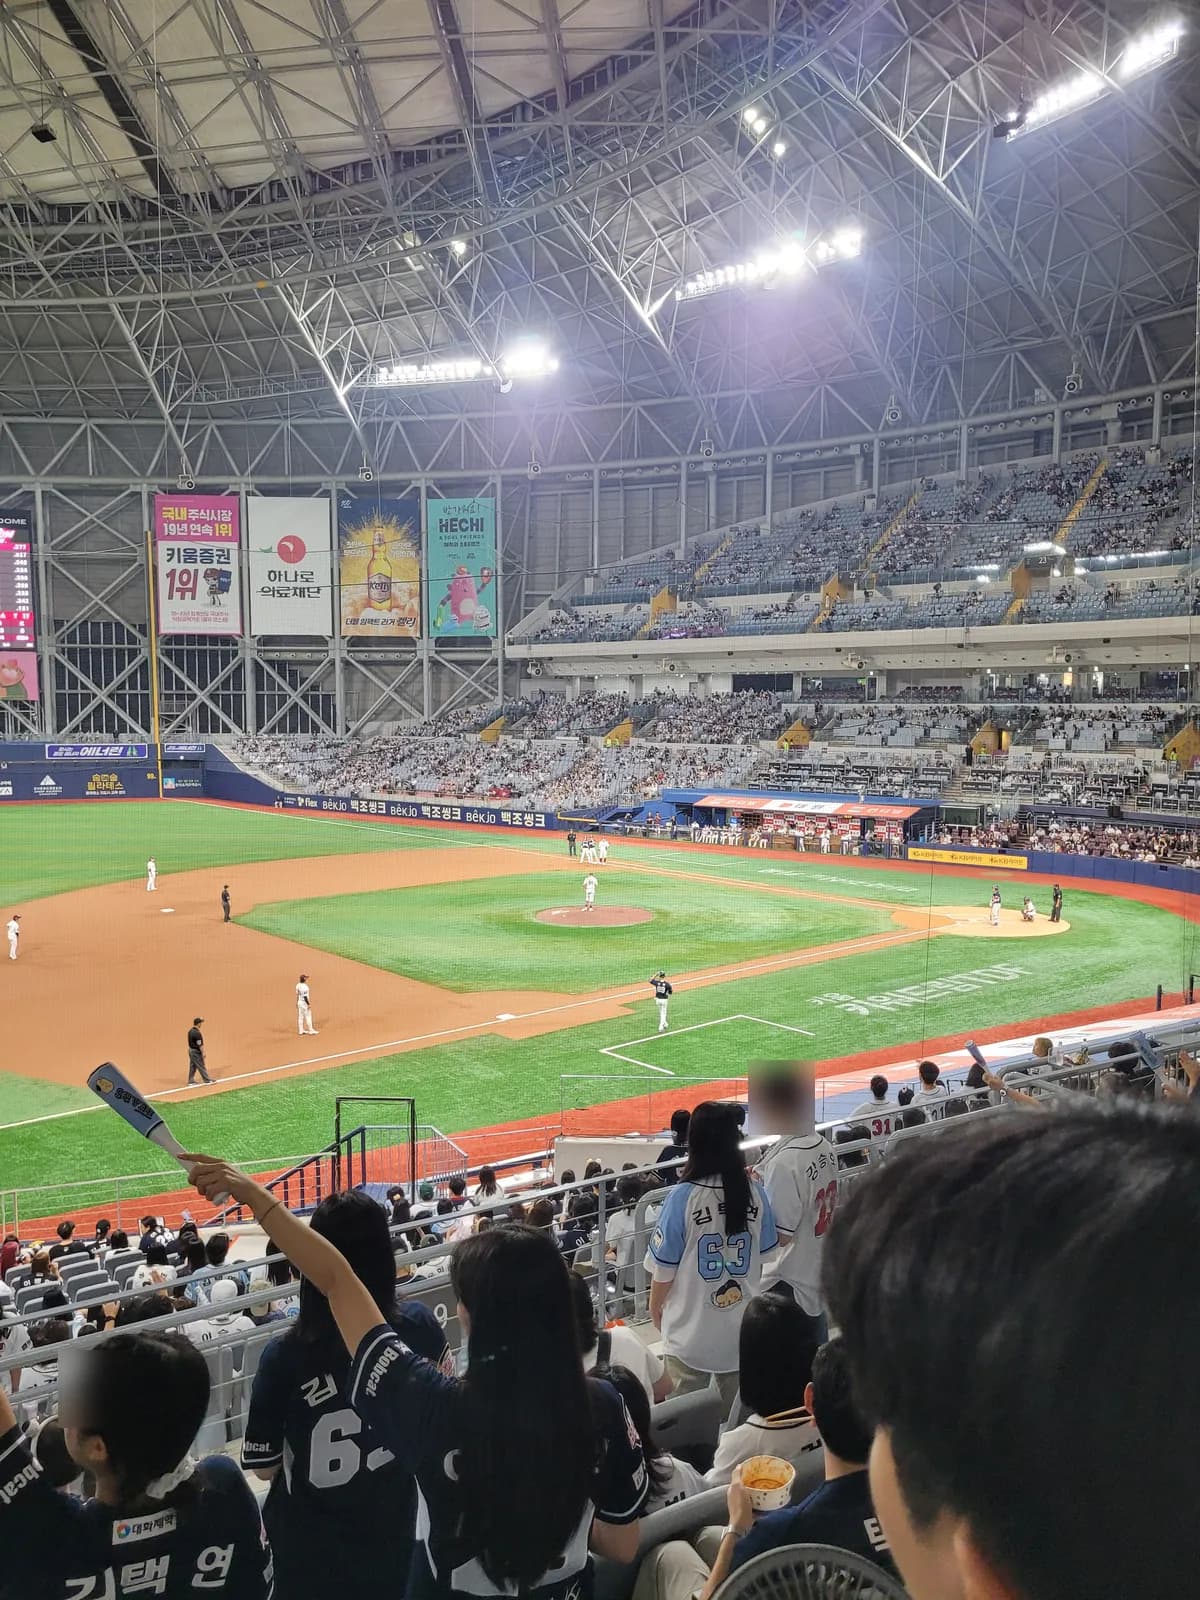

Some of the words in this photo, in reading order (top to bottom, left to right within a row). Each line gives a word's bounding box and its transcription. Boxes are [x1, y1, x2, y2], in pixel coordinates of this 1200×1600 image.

[162, 507, 187, 521] 국내
[188, 508, 232, 521] 주식시장
[163, 523, 188, 536] 19년
[190, 523, 213, 536] 연속
[215, 523, 232, 537] 1위
[439, 517, 484, 533] HECHI
[166, 547, 231, 564] 키움증권
[267, 569, 315, 583] 하나로
[166, 568, 199, 601] 1위
[260, 586, 322, 599] 의료재단
[370, 581, 391, 593] Kelly
[351, 799, 386, 814] 백조씽크
[421, 806, 461, 820] 백조씽크
[501, 811, 545, 827] 백조씽크
[872, 1119, 892, 1137] 31
[697, 1232, 752, 1282] 63
[365, 1346, 400, 1397] Bobcat
[131, 1513, 175, 1535] 대화제약
